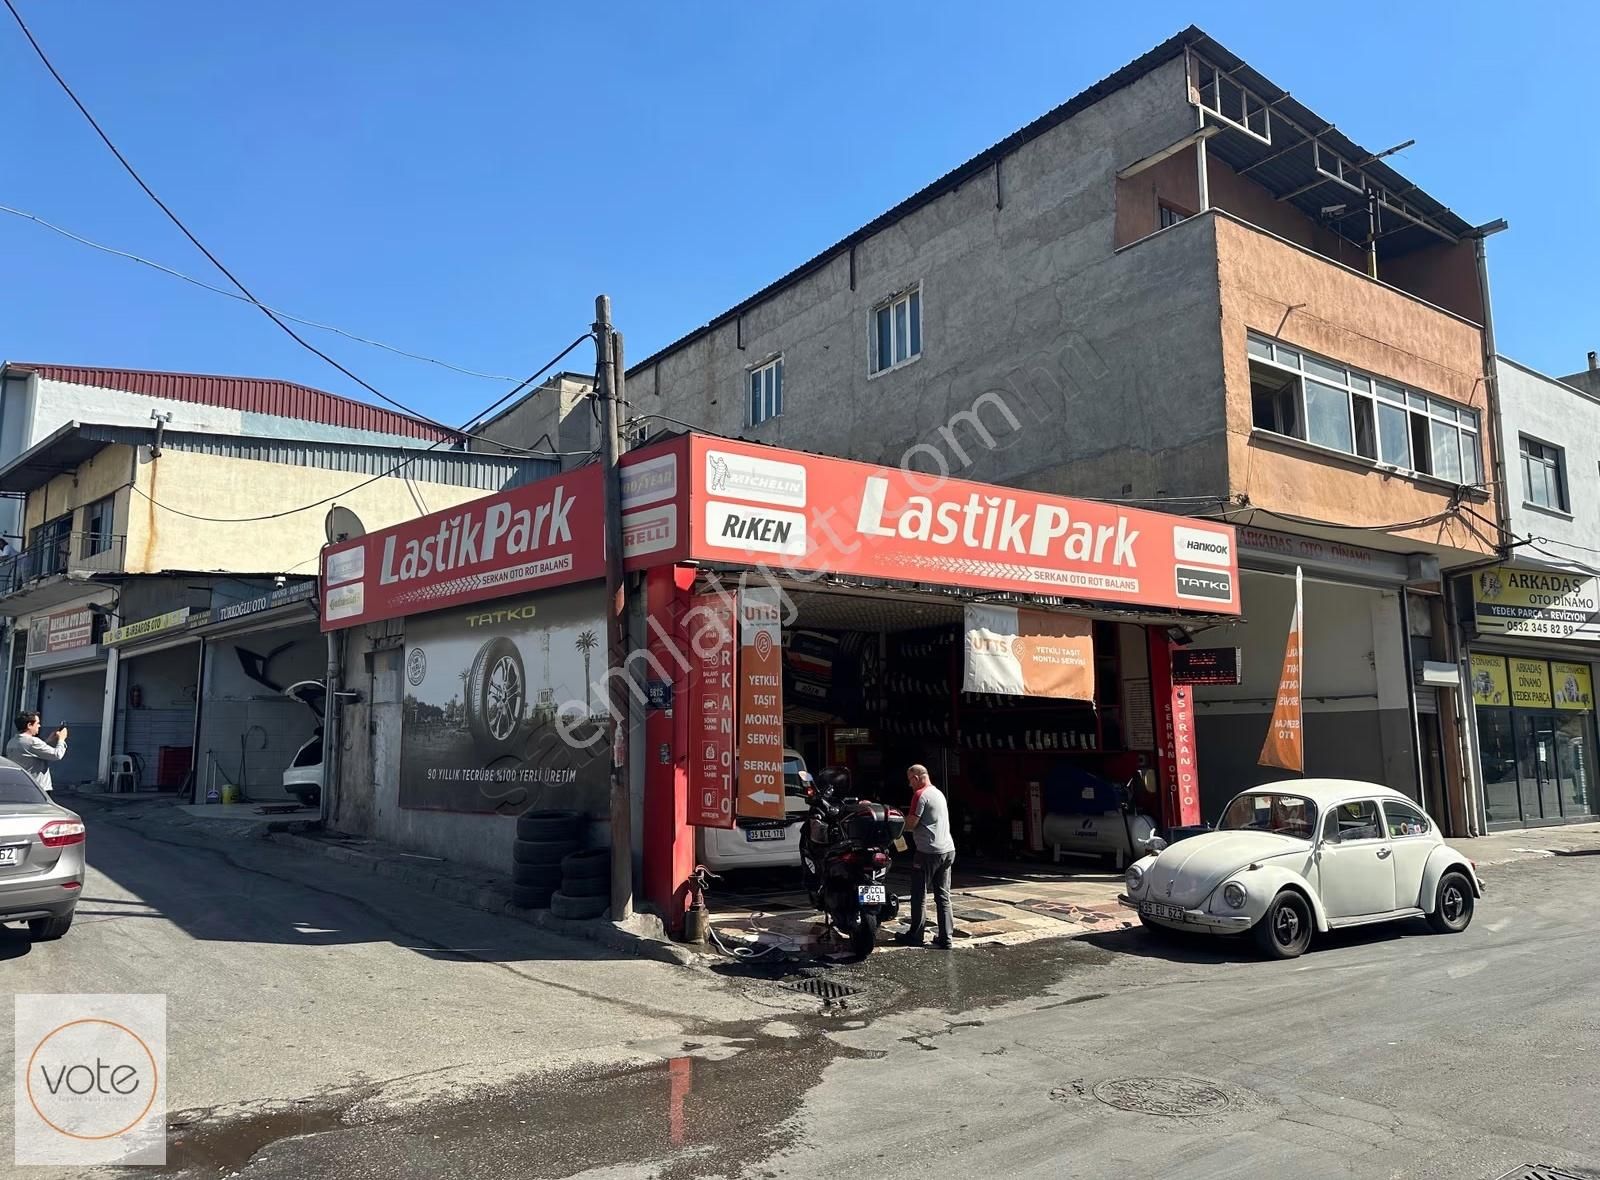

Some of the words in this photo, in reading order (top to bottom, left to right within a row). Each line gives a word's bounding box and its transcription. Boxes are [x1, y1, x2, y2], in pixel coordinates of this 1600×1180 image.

[729, 472, 801, 493] MICHELIN
[482, 571, 509, 585] SERKAN
[509, 567, 524, 580] OTO
[524, 564, 539, 576] ROT
[539, 557, 569, 573] BALANS
[1034, 570, 1068, 583] SERKAN
[1069, 575, 1087, 585] OTO
[1087, 576, 1104, 586] ROT
[1105, 578, 1136, 590] BALANS
[1178, 577, 1229, 591] TATKO
[1508, 573, 1581, 597] ARKADAŞ
[252, 597, 267, 612] OTO
[1528, 593, 1551, 605] OTO
[1553, 595, 1594, 609] DİNAMO
[465, 605, 536, 627] TATKO
[1491, 606, 1516, 616] YEDEK
[1518, 608, 1543, 620] PARÇA
[1550, 610, 1586, 622] REVİZYON
[1507, 620, 1529, 632] 0532
[1531, 622, 1548, 633] 345
[1551, 624, 1561, 634] 82
[1563, 625, 1574, 635] 89
[973, 638, 1008, 653] UTTS
[1032, 655, 1060, 664] MONTAJ
[1516, 662, 1542, 674] ARKADAŞ
[749, 672, 779, 686] YETKİLİ
[1519, 675, 1542, 688] DİNAMO
[753, 694, 777, 708] TAŞIT
[1513, 691, 1532, 701] YEDEK
[1532, 691, 1550, 704] PARÇA
[1177, 699, 1191, 765] SERKAN
[743, 760, 781, 772] SERKAN
[427, 769, 437, 780] 90
[438, 768, 461, 780] YILLIK
[462, 767, 495, 781] TECRÜBE
[519, 768, 543, 782] YERLİ
[544, 767, 577, 783] ÜRETİM
[754, 774, 775, 785] OTO
[1182, 773, 1194, 805] OTO
